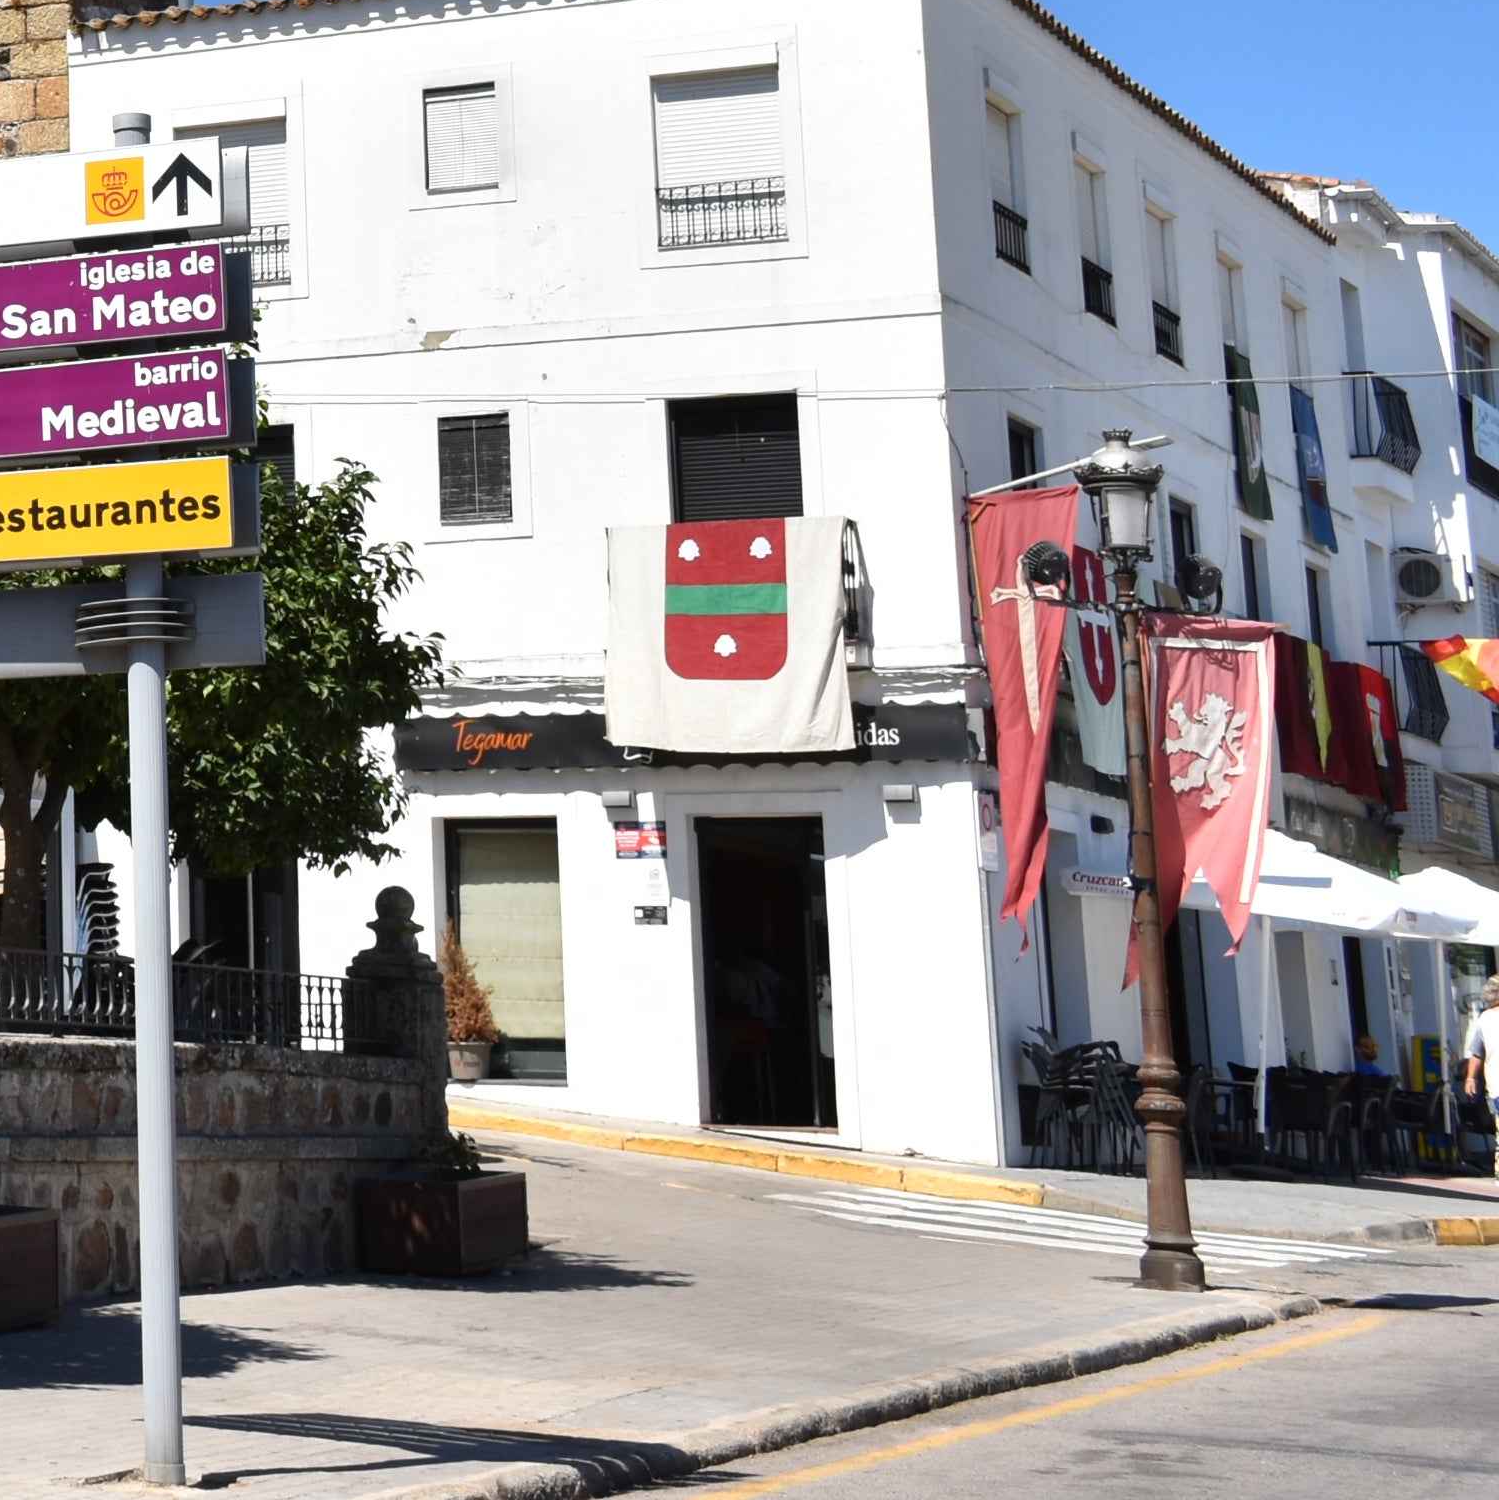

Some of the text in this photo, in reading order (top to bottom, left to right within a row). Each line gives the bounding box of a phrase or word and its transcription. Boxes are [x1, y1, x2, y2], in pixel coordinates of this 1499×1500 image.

[80, 249, 215, 290] iglesia de
[1, 288, 217, 339] San Mateo
[134, 357, 219, 387] barrio
[41, 390, 222, 442] Medieval
[856, 721, 900, 746] idas
